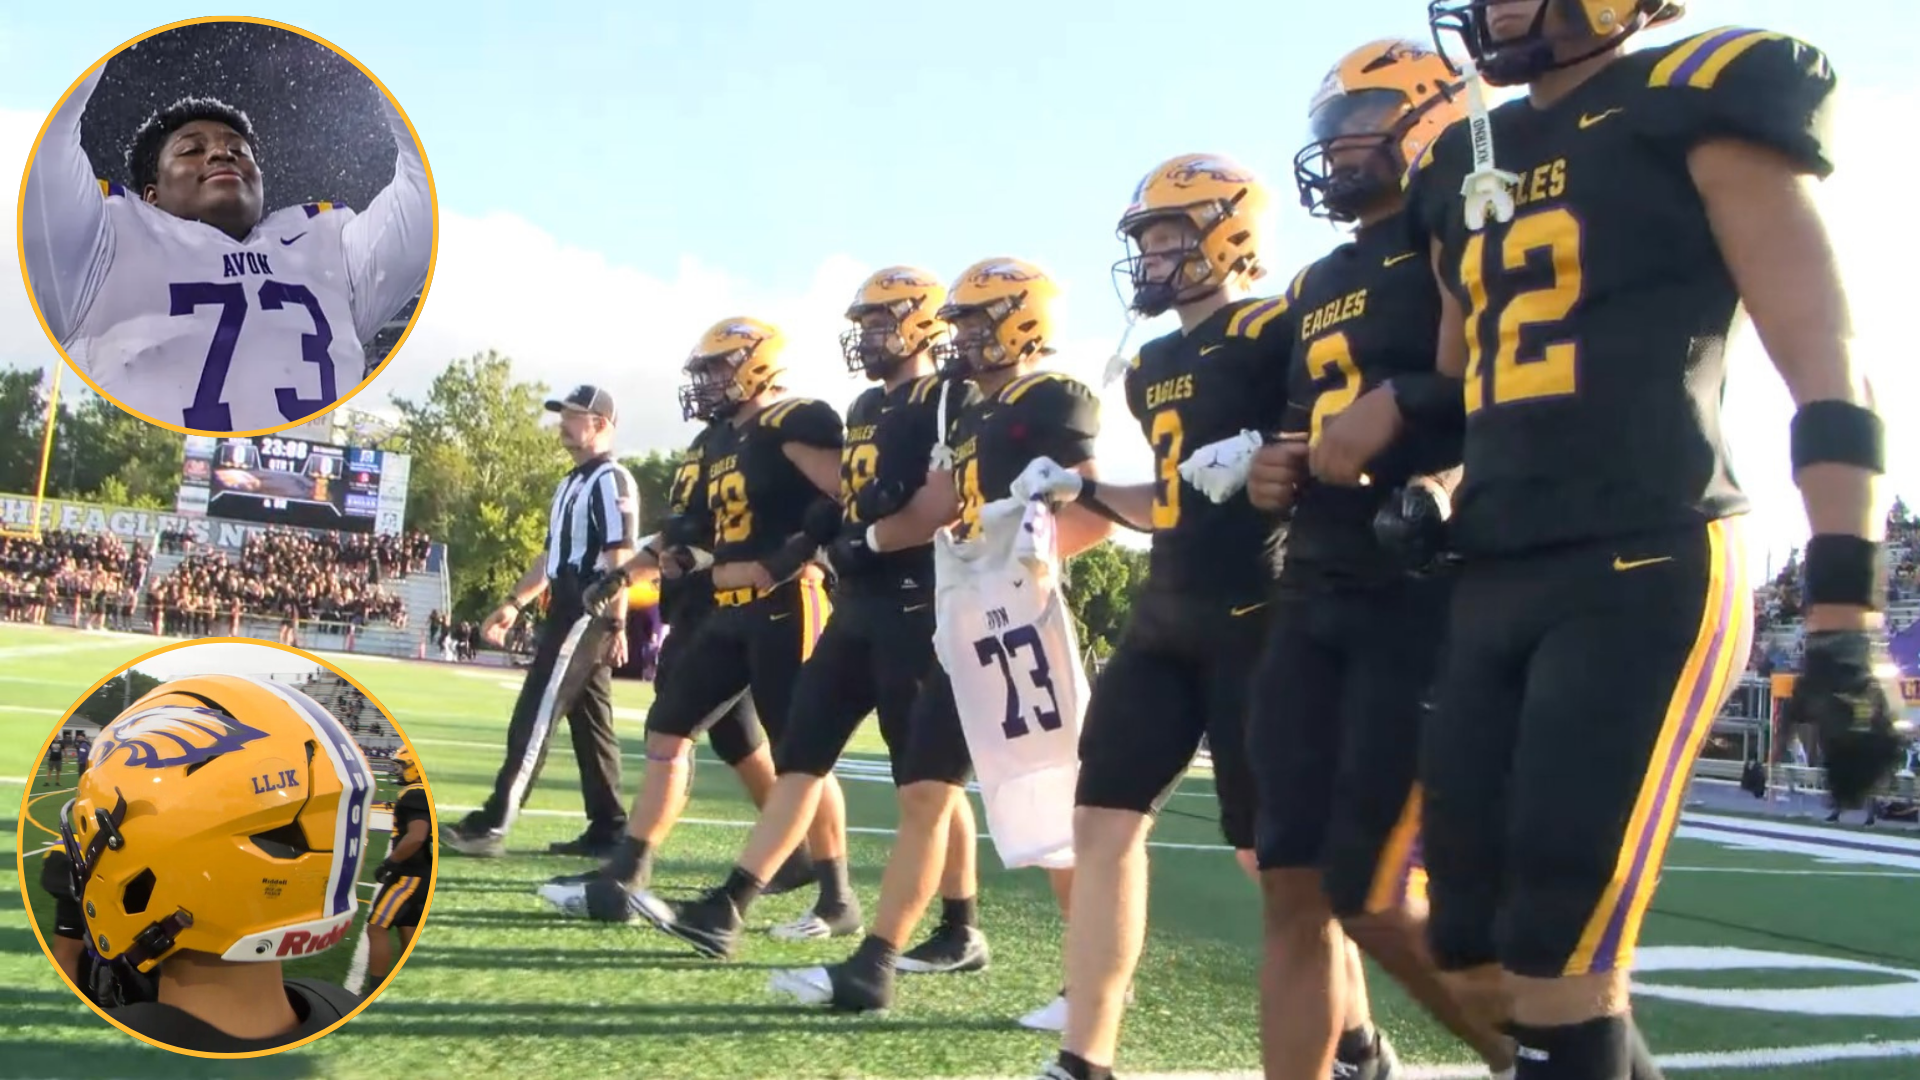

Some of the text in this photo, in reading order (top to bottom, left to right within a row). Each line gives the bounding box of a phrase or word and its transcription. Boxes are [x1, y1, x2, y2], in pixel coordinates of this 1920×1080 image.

[222, 252, 273, 278] AVON
[1301, 288, 1368, 341] EAGLES
[1460, 207, 1582, 416] 12
[169, 279, 338, 432] 73
[1146, 373, 1193, 410] EAGLES
[1306, 331, 1363, 449] 2
[60, 505, 210, 544] EAGLE'S
[1151, 409, 1184, 529] 3
[973, 623, 1063, 740] 73
[252, 769, 300, 795] LLJK
[340, 743, 368, 858] AVON
